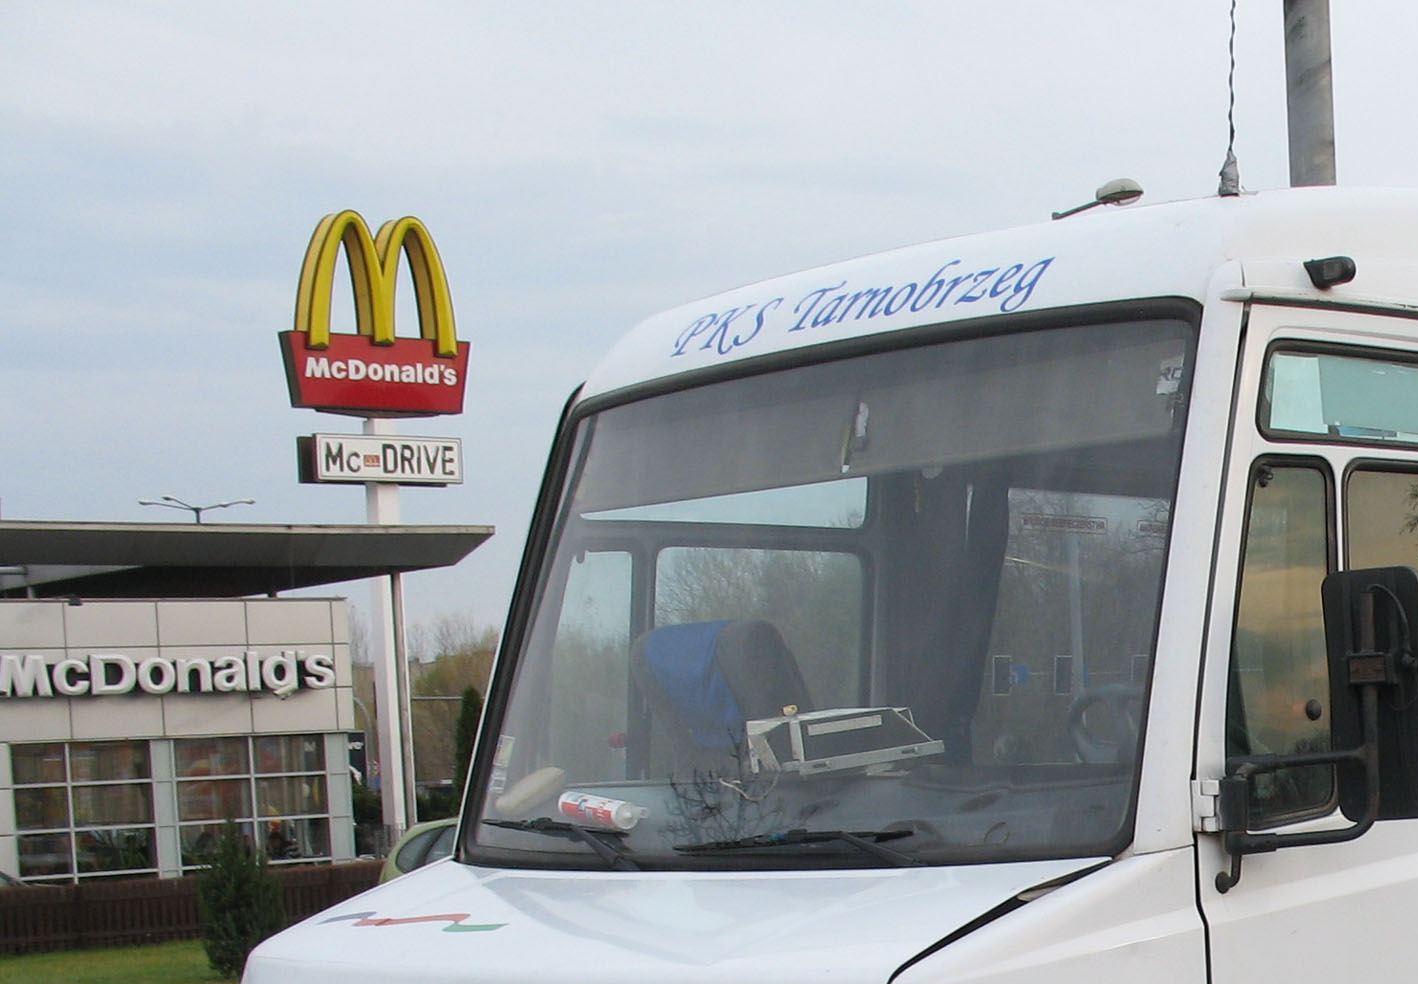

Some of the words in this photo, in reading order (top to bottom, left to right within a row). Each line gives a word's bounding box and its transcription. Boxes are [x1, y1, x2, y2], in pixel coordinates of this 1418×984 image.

[670, 297, 784, 357] PKS
[788, 256, 1056, 333] Tarnobrzeg
[305, 356, 458, 386] McDonald's
[0, 651, 336, 697] McDonald's
